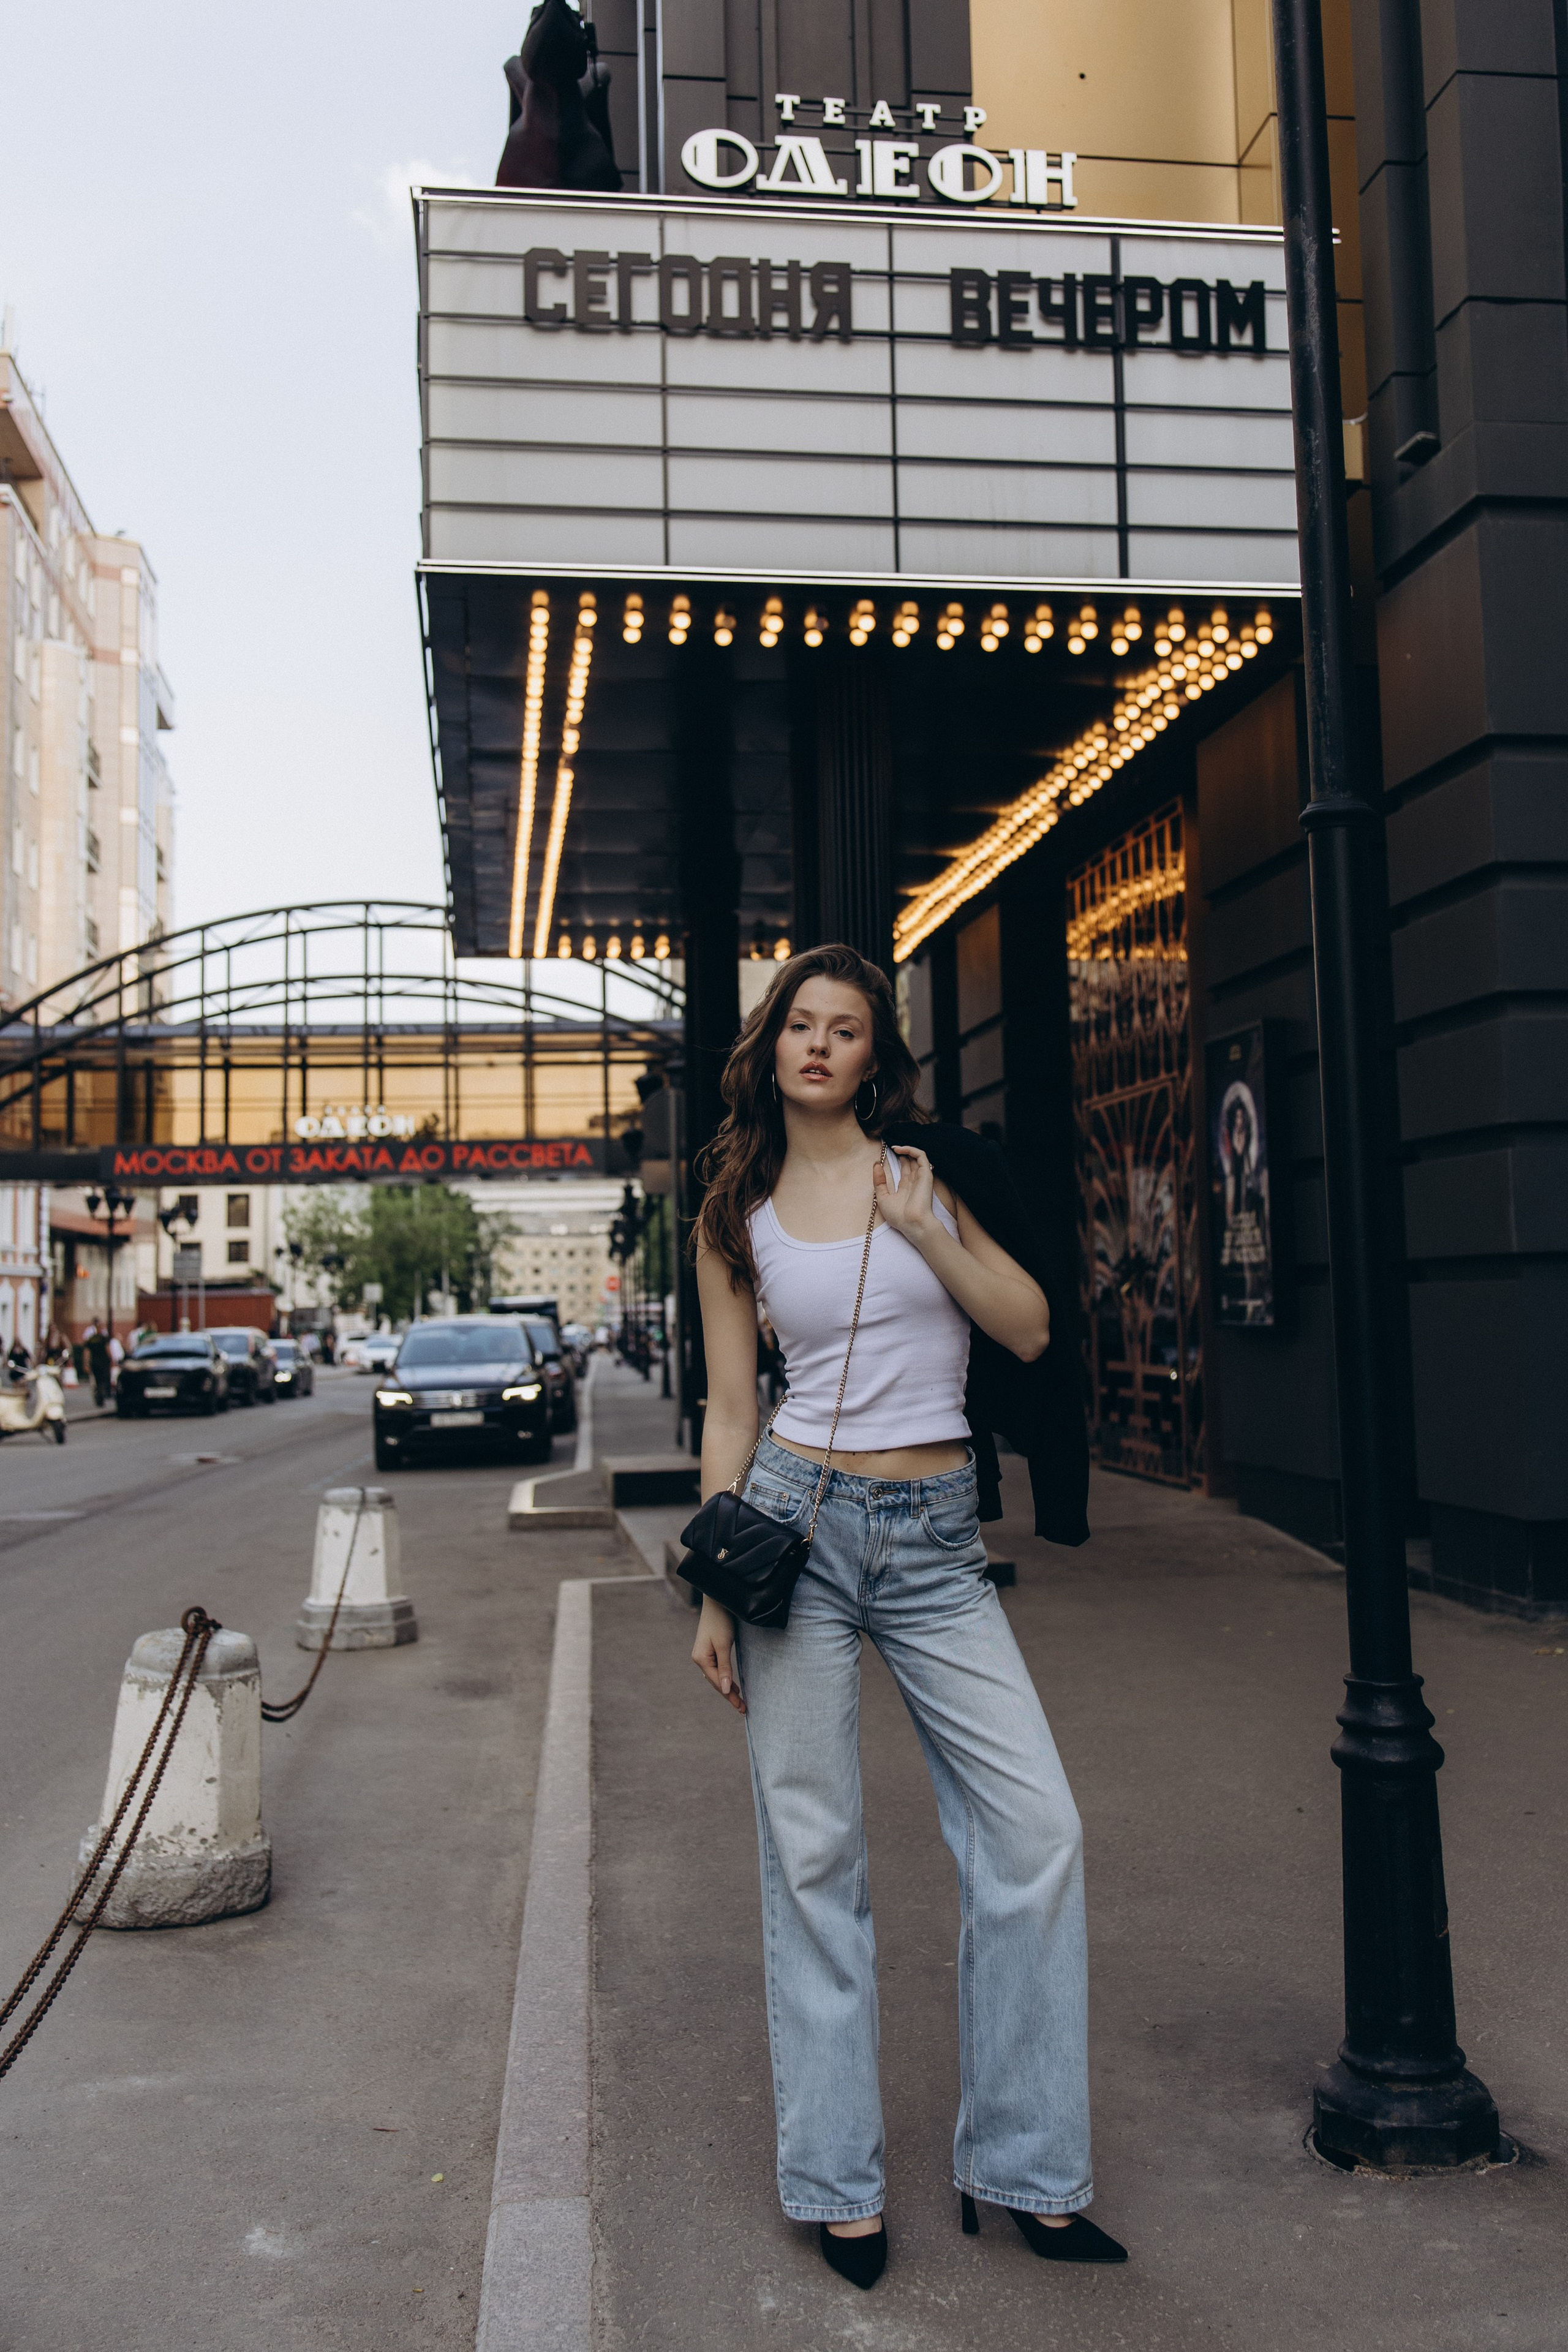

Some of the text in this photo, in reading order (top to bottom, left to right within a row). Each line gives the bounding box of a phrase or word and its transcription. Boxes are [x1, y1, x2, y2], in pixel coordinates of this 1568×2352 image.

[775, 93, 987, 132] ТЕАТР
[680, 128, 1078, 206] ОДЕОН
[523, 247, 1266, 354] СЕГОДНЯ ВЕЧЕРОМ
[113, 1142, 594, 1175] МОСКВА ОТ ЗАКАТА ДО РАССВЕТА
